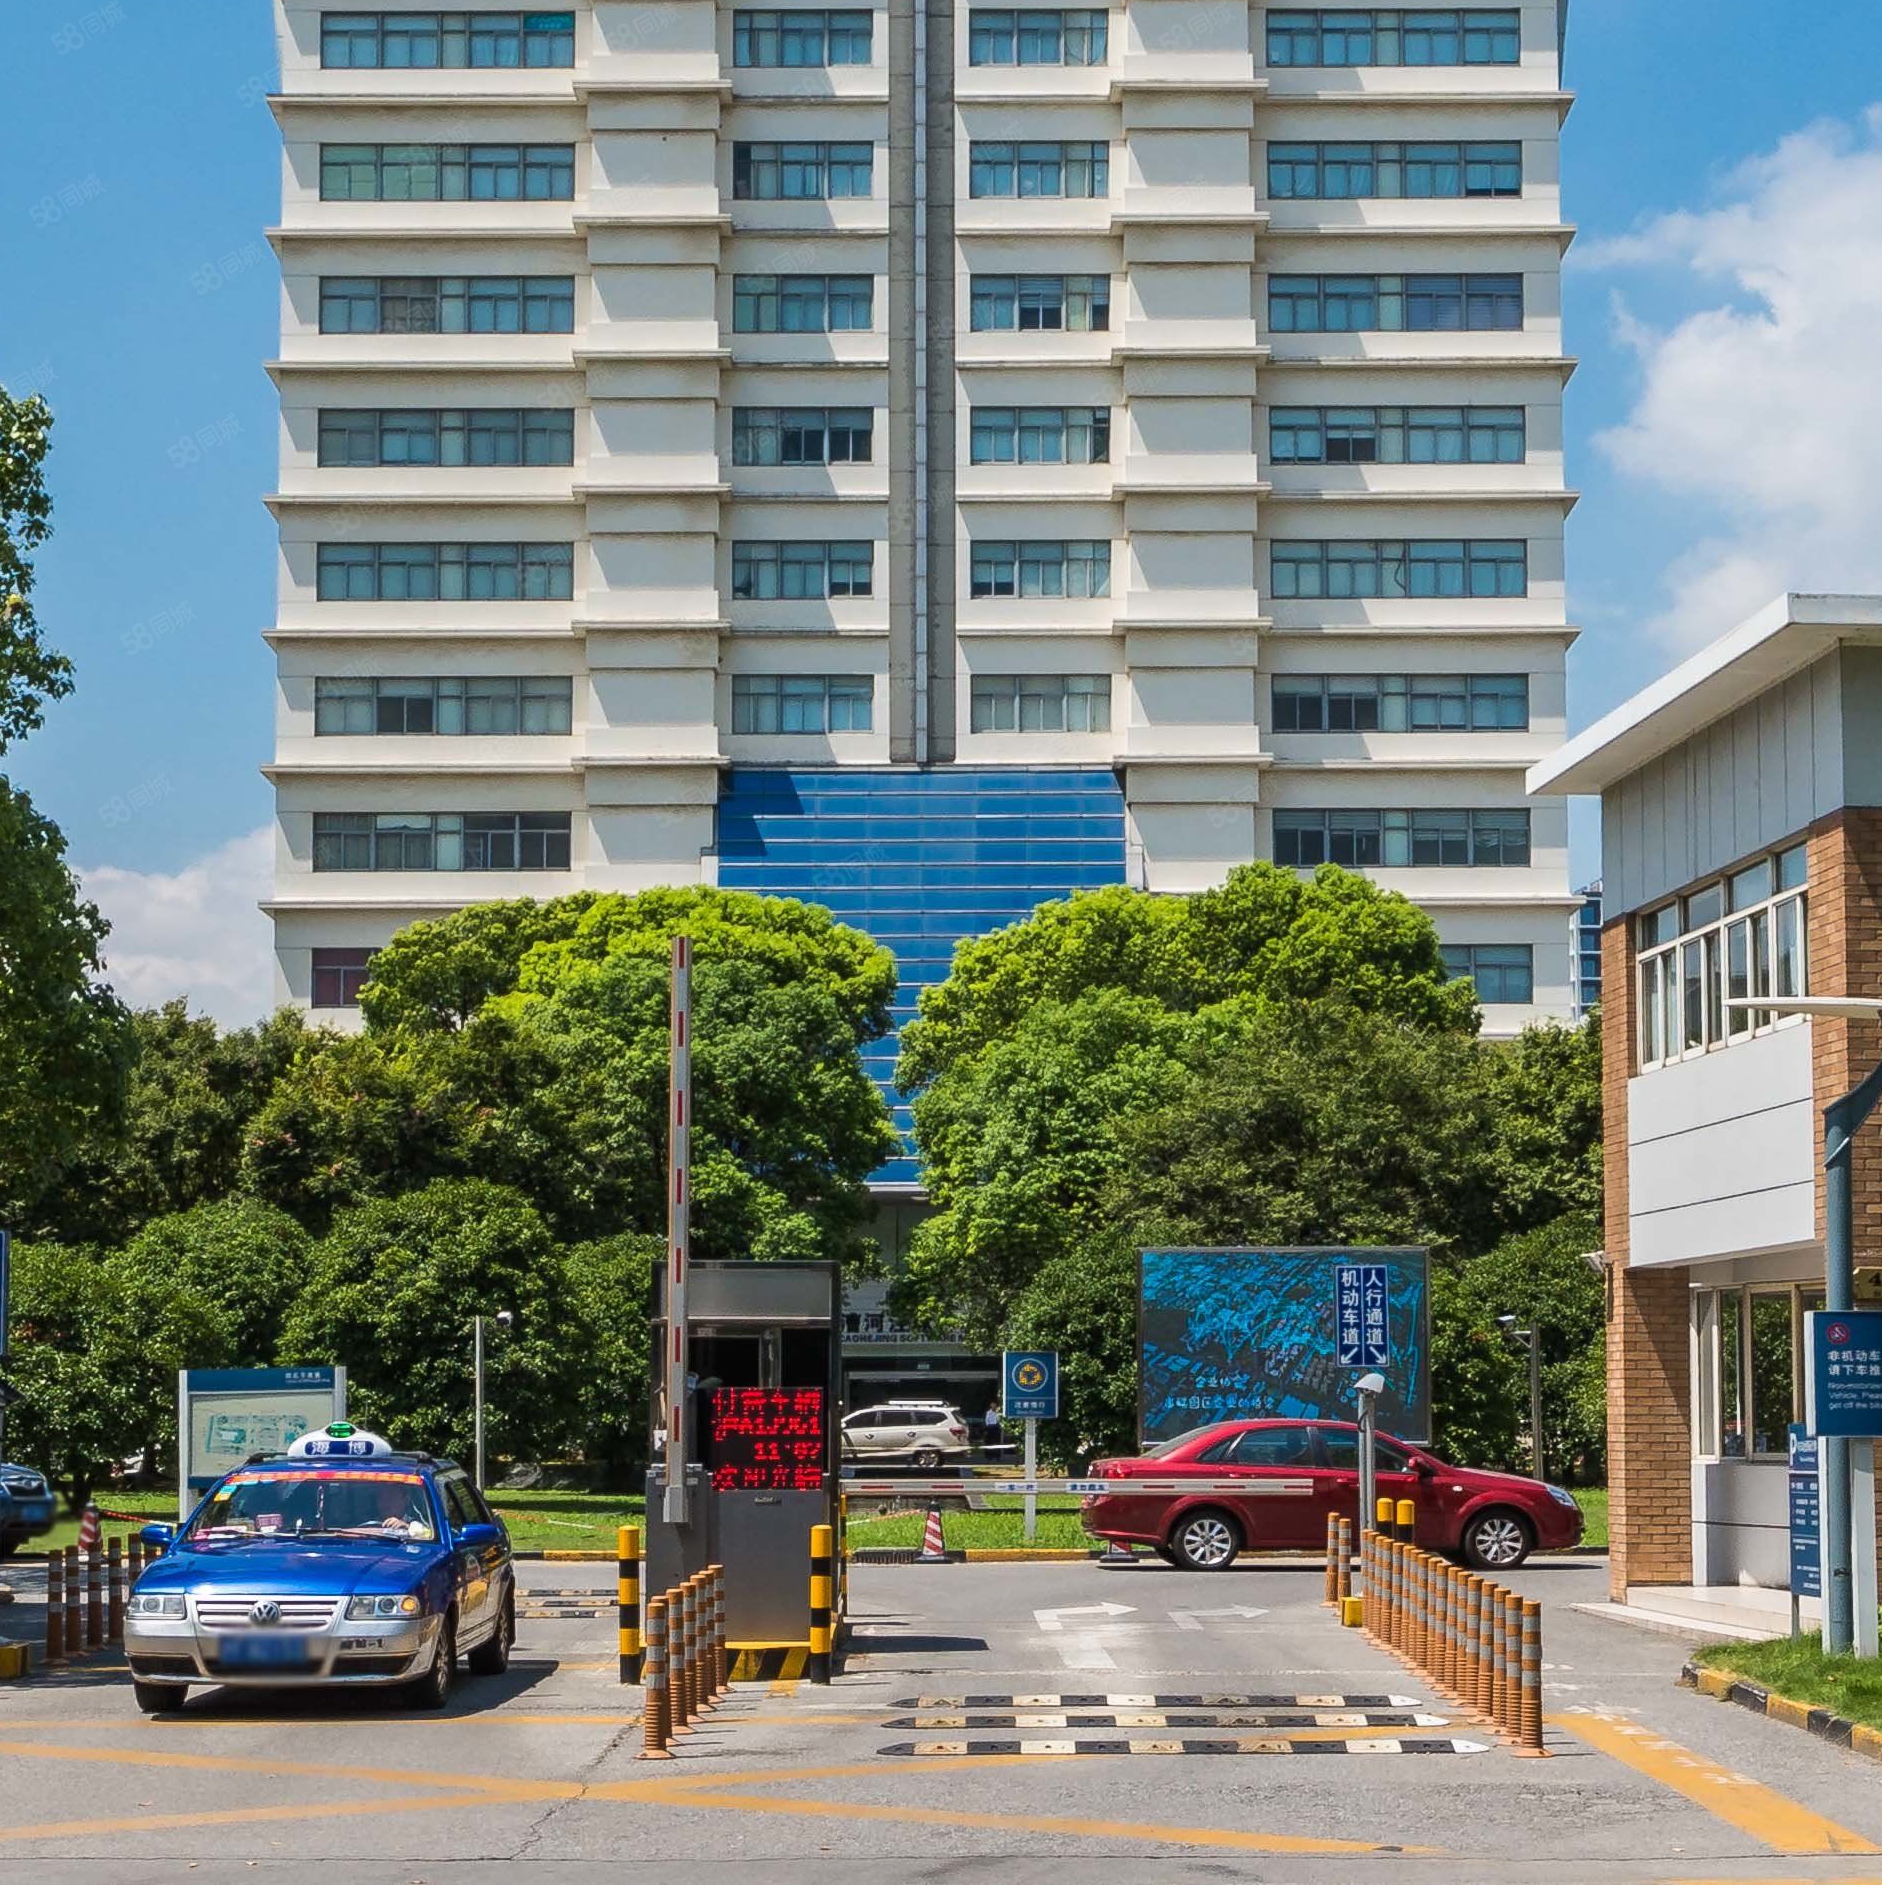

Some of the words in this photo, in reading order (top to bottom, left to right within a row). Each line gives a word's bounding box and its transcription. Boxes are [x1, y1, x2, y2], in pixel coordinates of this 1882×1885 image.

[1341, 1268, 1361, 1345] 机动车道
[1365, 1268, 1385, 1345] 人行通道
[1827, 1350, 1881, 1362] 非机动车
